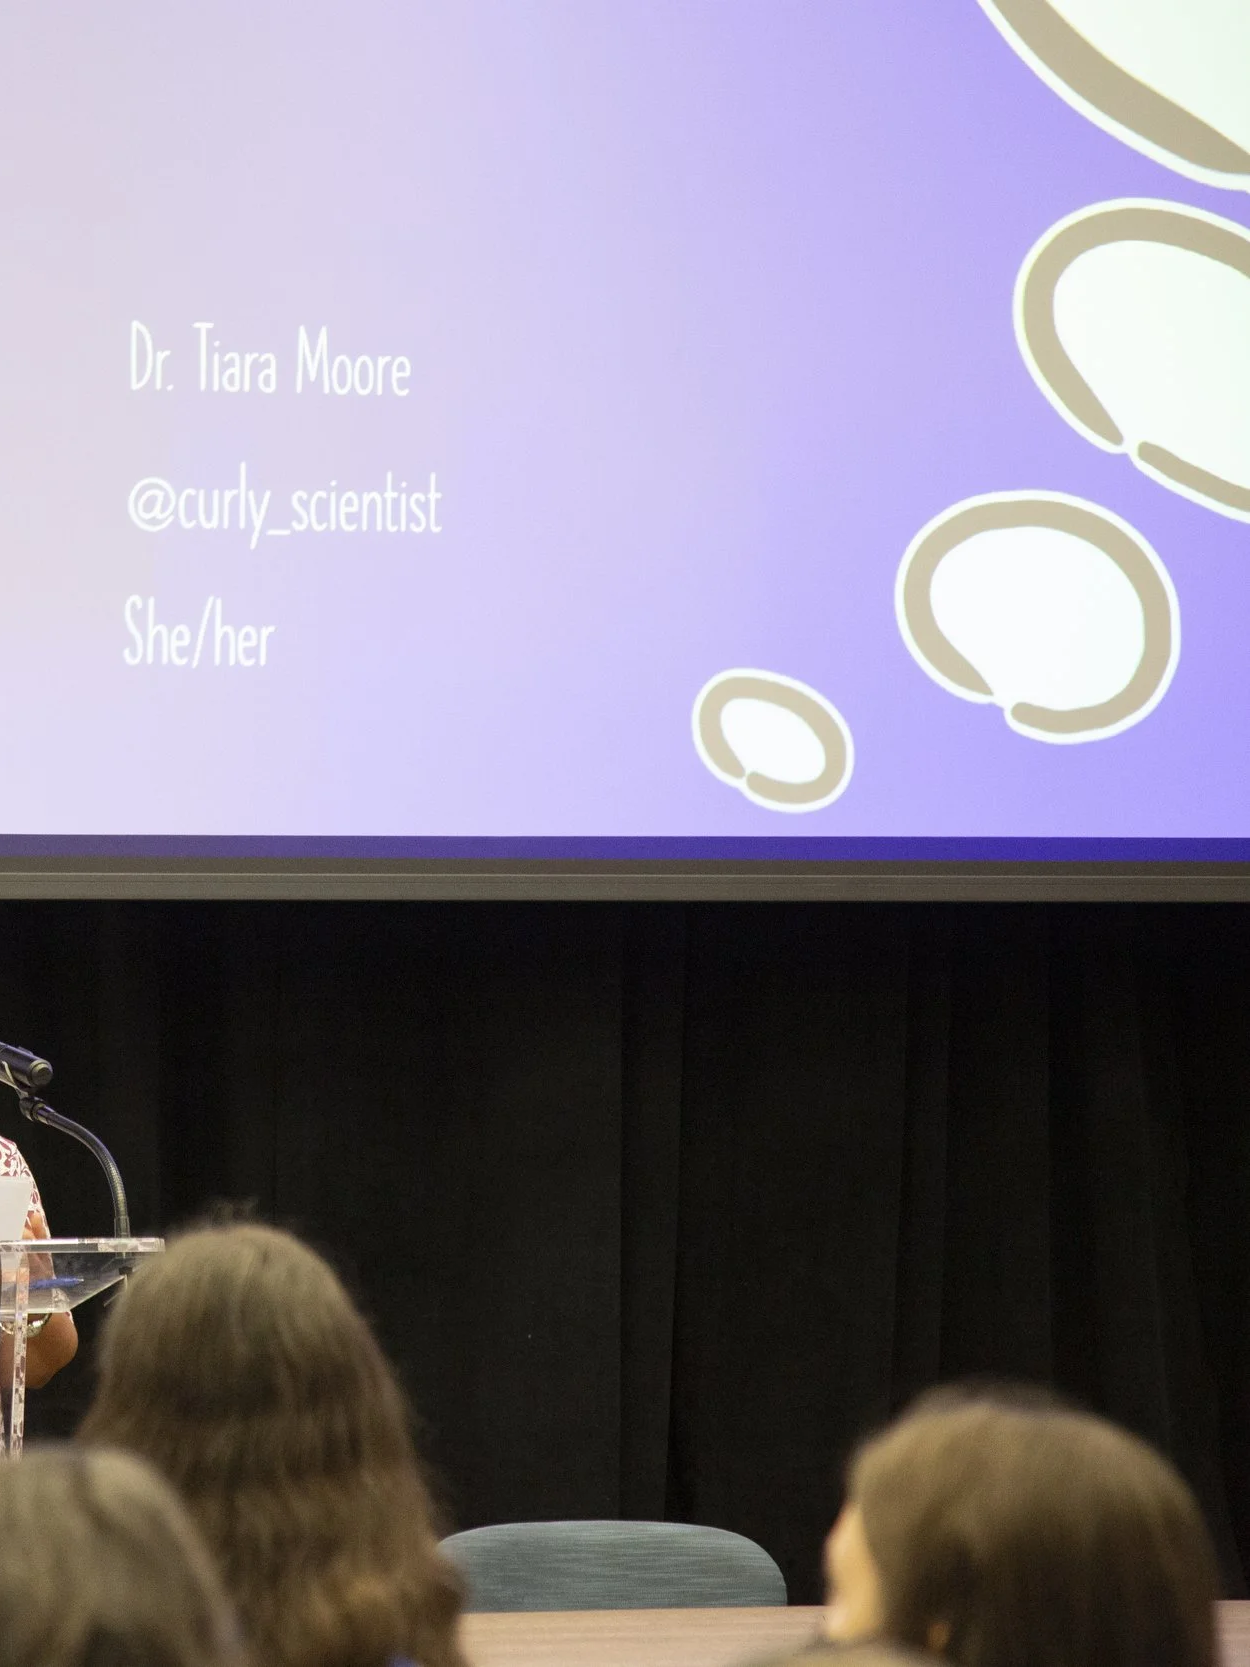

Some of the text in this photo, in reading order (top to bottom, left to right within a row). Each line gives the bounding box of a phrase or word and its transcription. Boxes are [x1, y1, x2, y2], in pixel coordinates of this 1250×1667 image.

[129, 319, 412, 397] Dr. Tiara Moore
[126, 460, 444, 551] @curly_scientist
[122, 594, 278, 669] She/her
